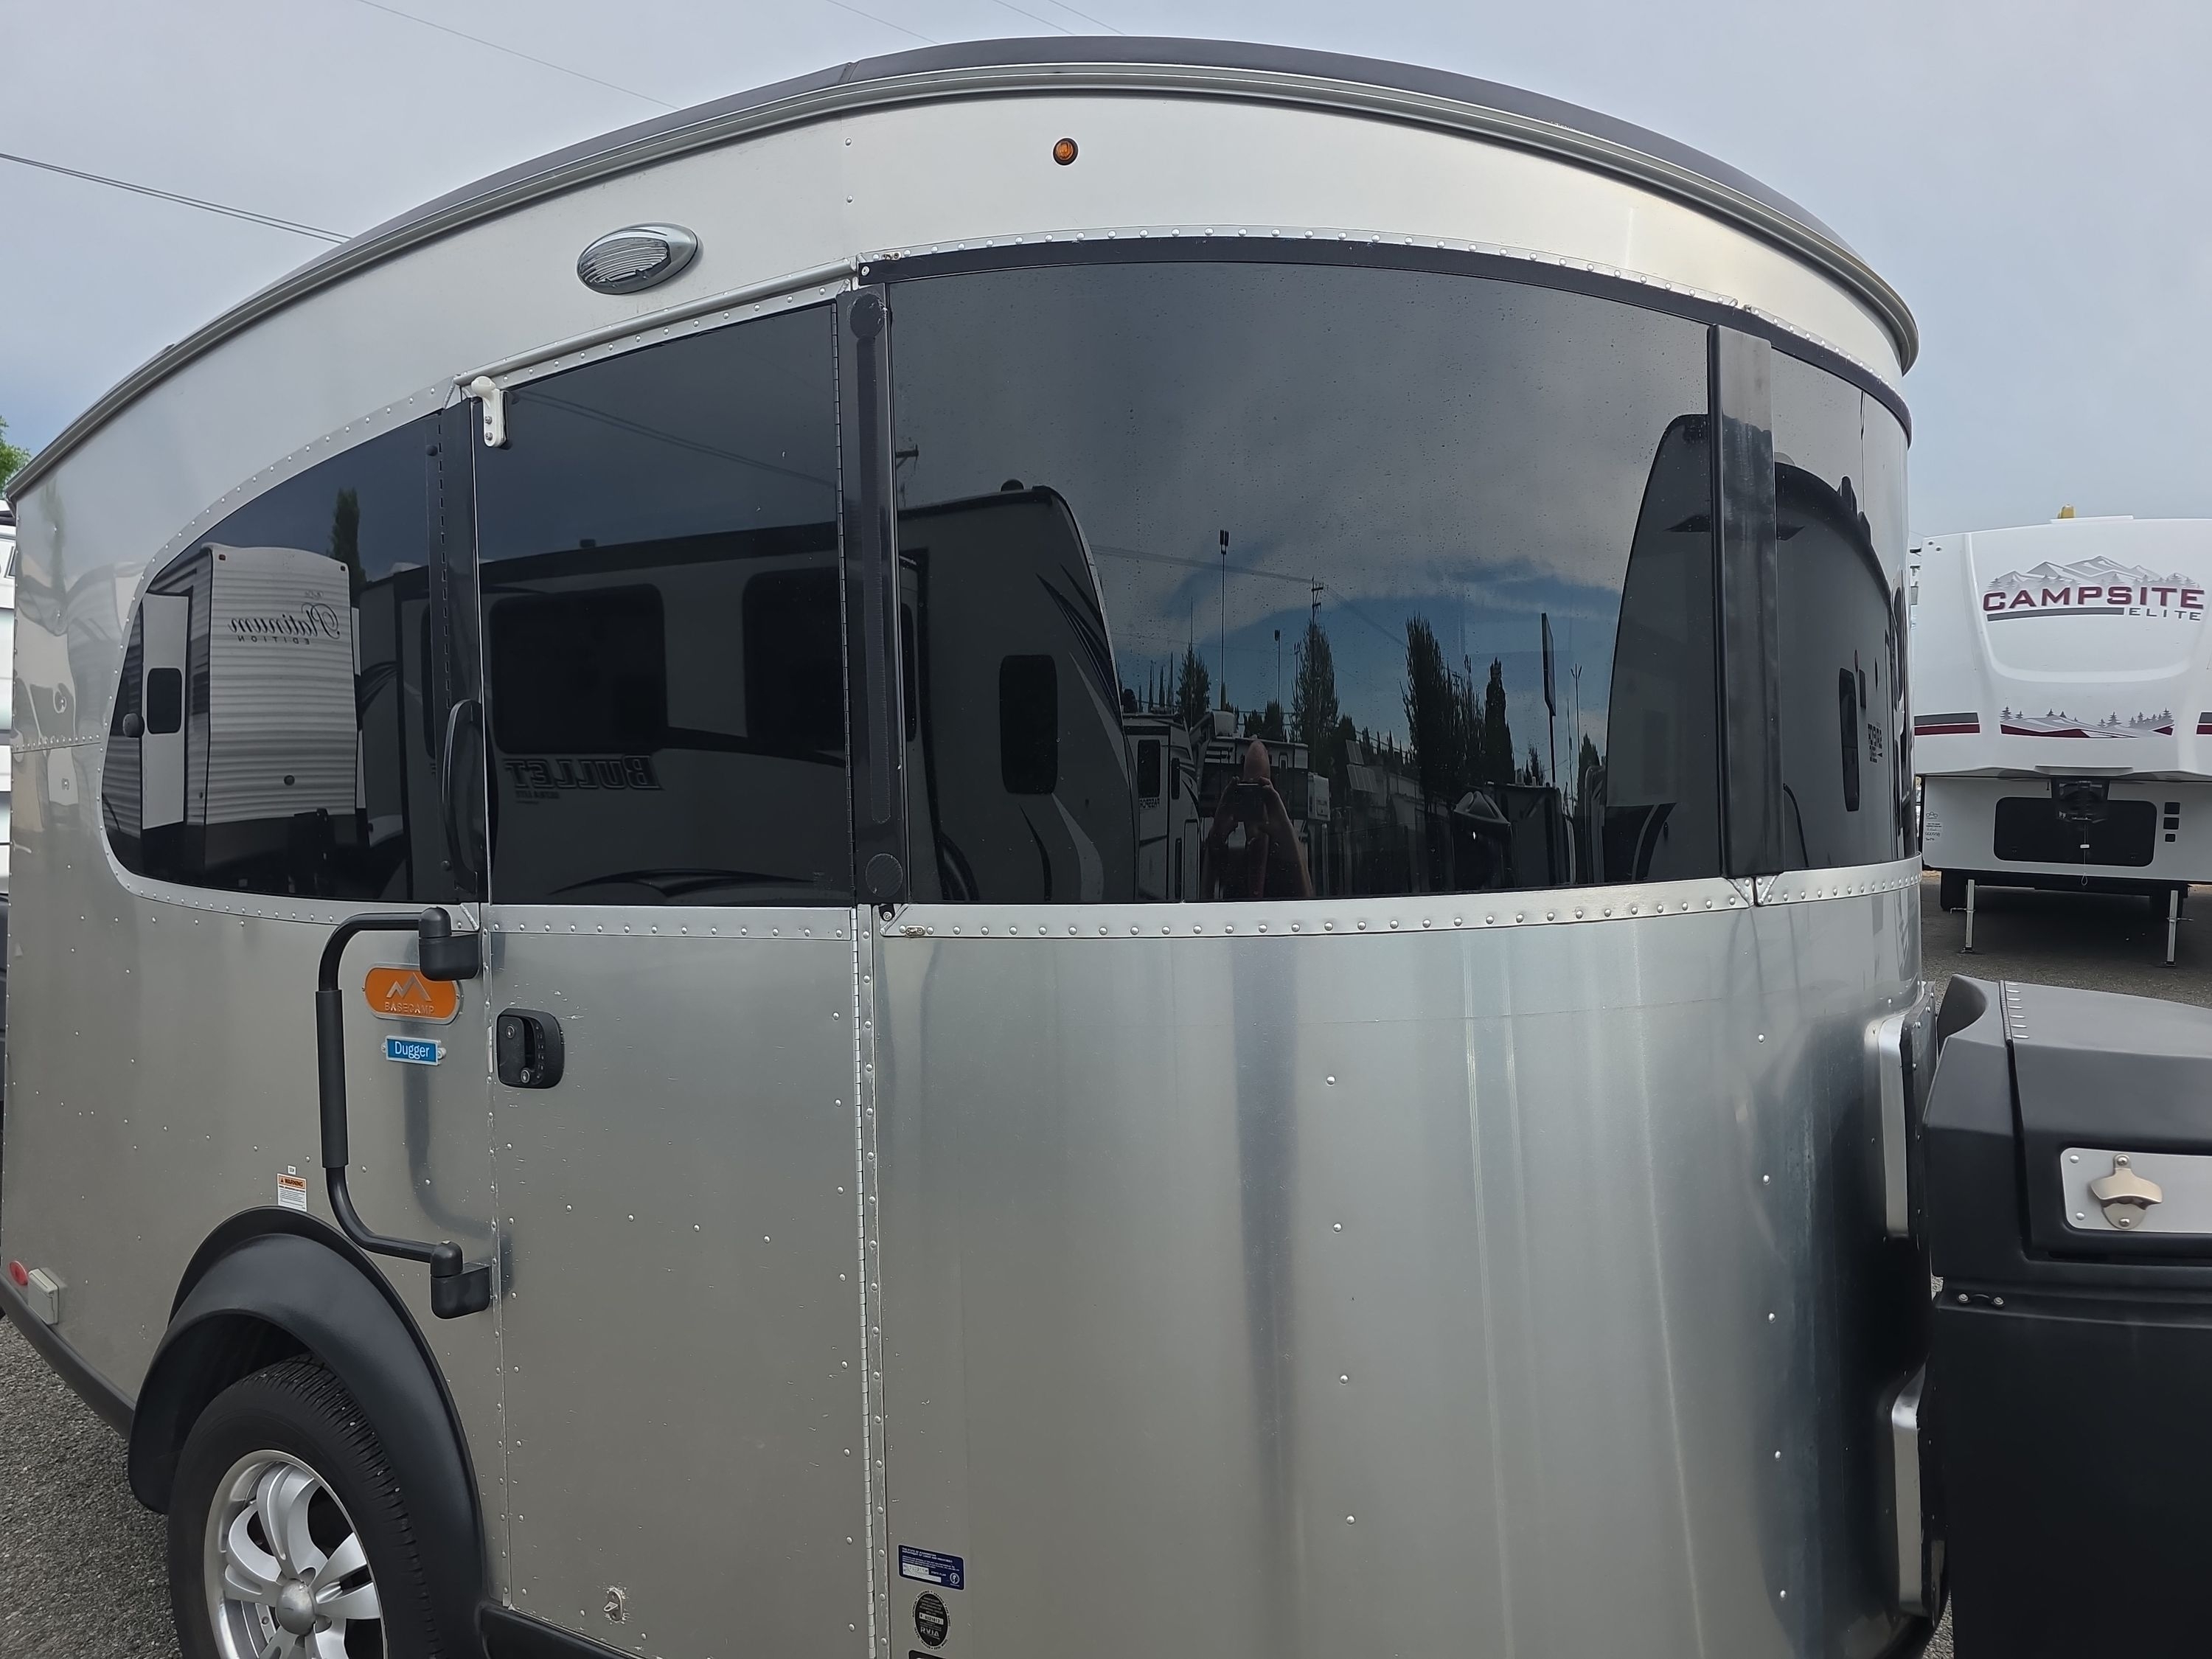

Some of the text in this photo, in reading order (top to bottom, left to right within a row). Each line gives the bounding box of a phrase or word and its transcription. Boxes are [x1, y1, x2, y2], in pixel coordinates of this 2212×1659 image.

[1983, 585, 2205, 612] CAMPSITE
[2128, 607, 2202, 622] ELITE
[384, 1001, 435, 1015] BASECAMP
[394, 1041, 430, 1060] Dugger
[285, 1178, 303, 1186] WARNING
[920, 1626, 939, 1637] RVIA
